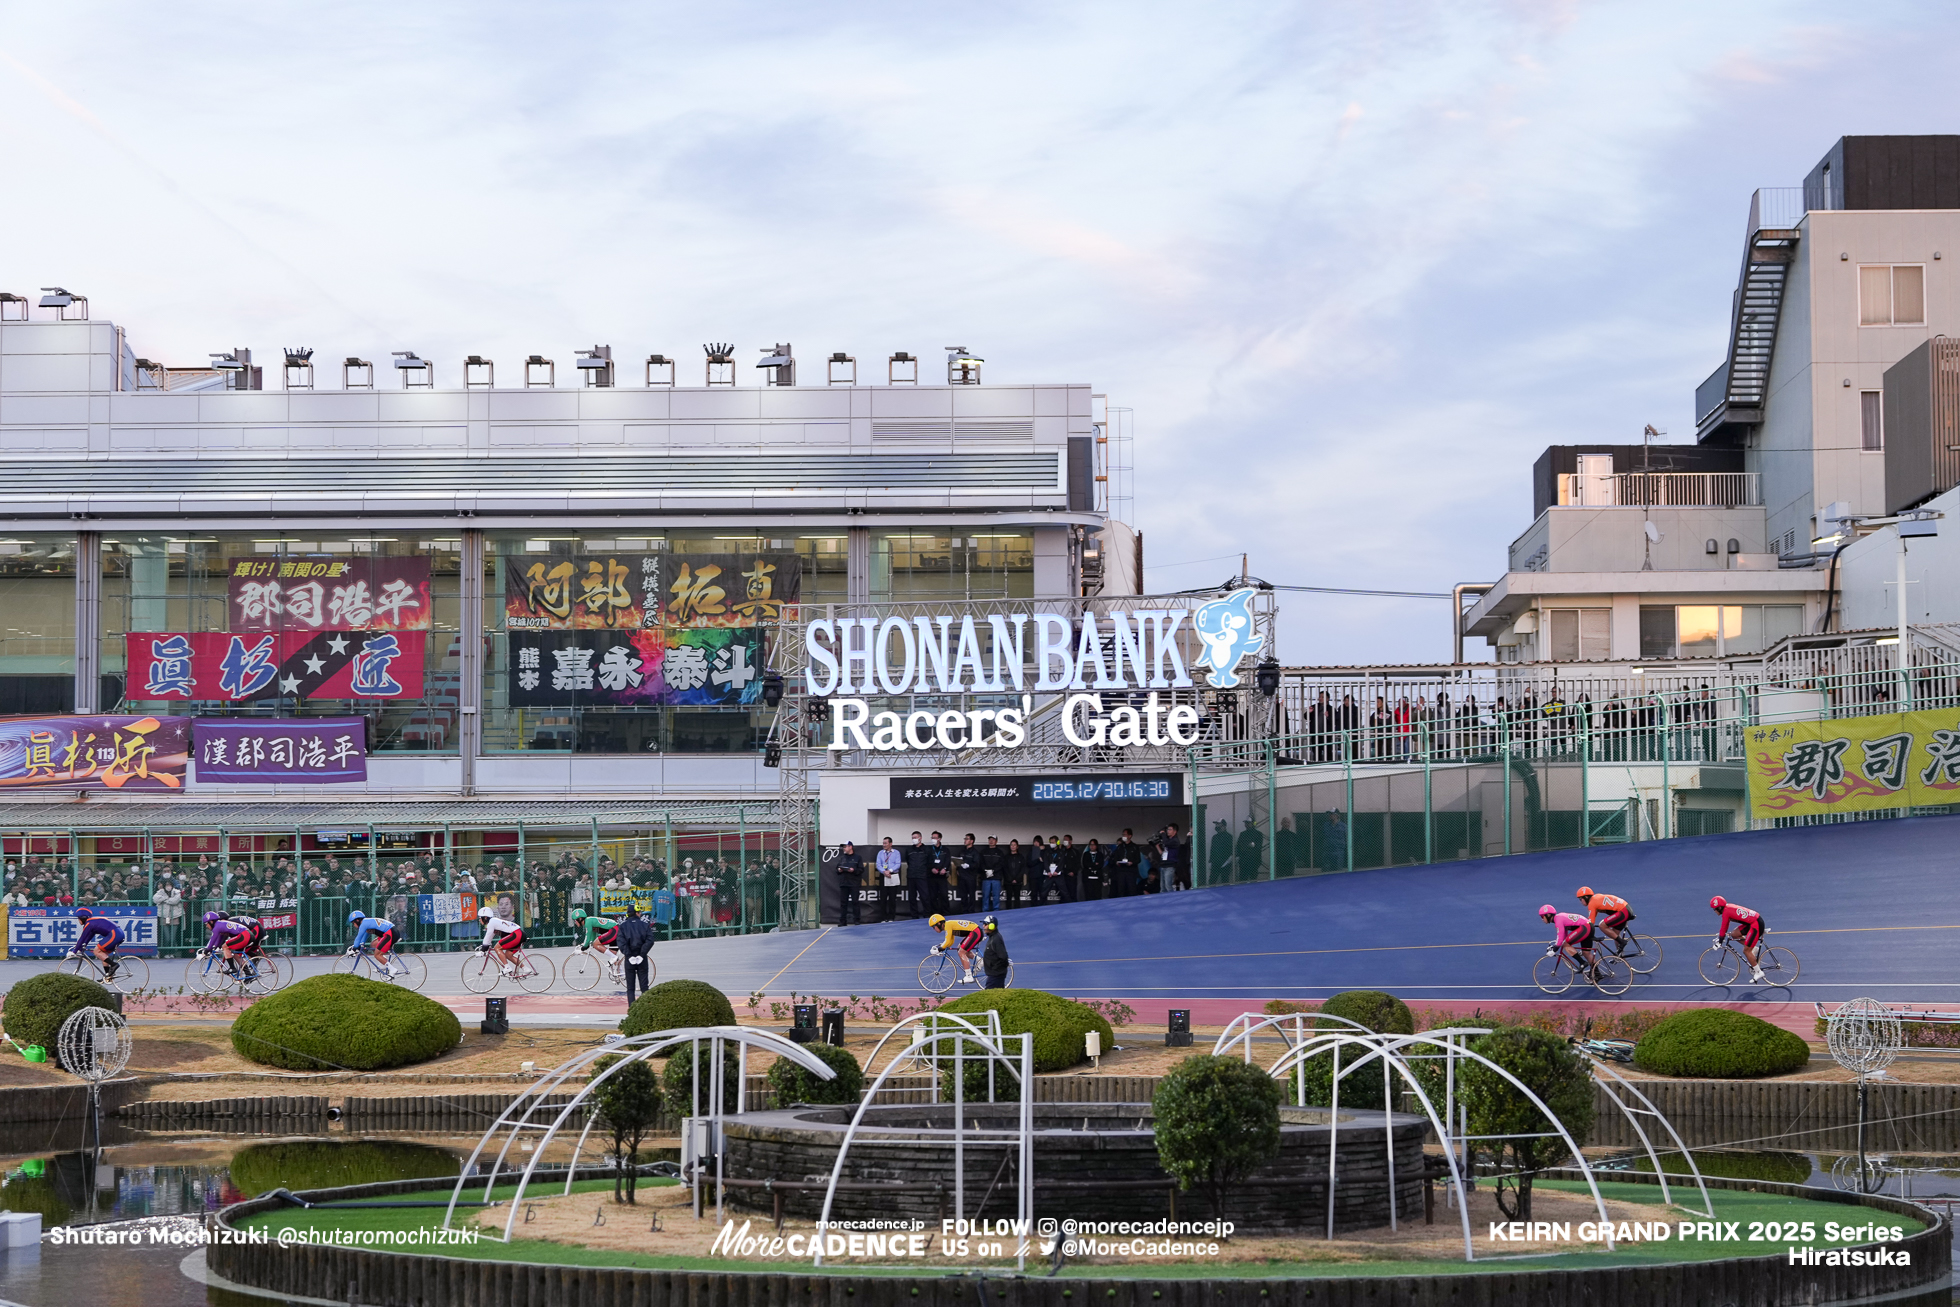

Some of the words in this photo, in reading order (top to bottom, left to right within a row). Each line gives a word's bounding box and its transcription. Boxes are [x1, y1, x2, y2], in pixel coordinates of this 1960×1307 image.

[236, 579, 420, 627] 郡司浩平
[805, 613, 1028, 697] SHONAN
[1034, 608, 1193, 692] BANK
[519, 647, 540, 691] 熊本
[828, 695, 1032, 751] Racers'
[1061, 692, 1200, 747] Gate
[1753, 728, 1795, 743] 神奈川
[97, 747, 116, 761] 113
[204, 735, 361, 769] 漢郡司浩平
[905, 788, 1020, 798] 来るぞ、人生を変える瞬間が。
[1602, 896, 1615, 908] 7
[1736, 908, 1749, 919] 3
[14, 920, 153, 943] 古性作
